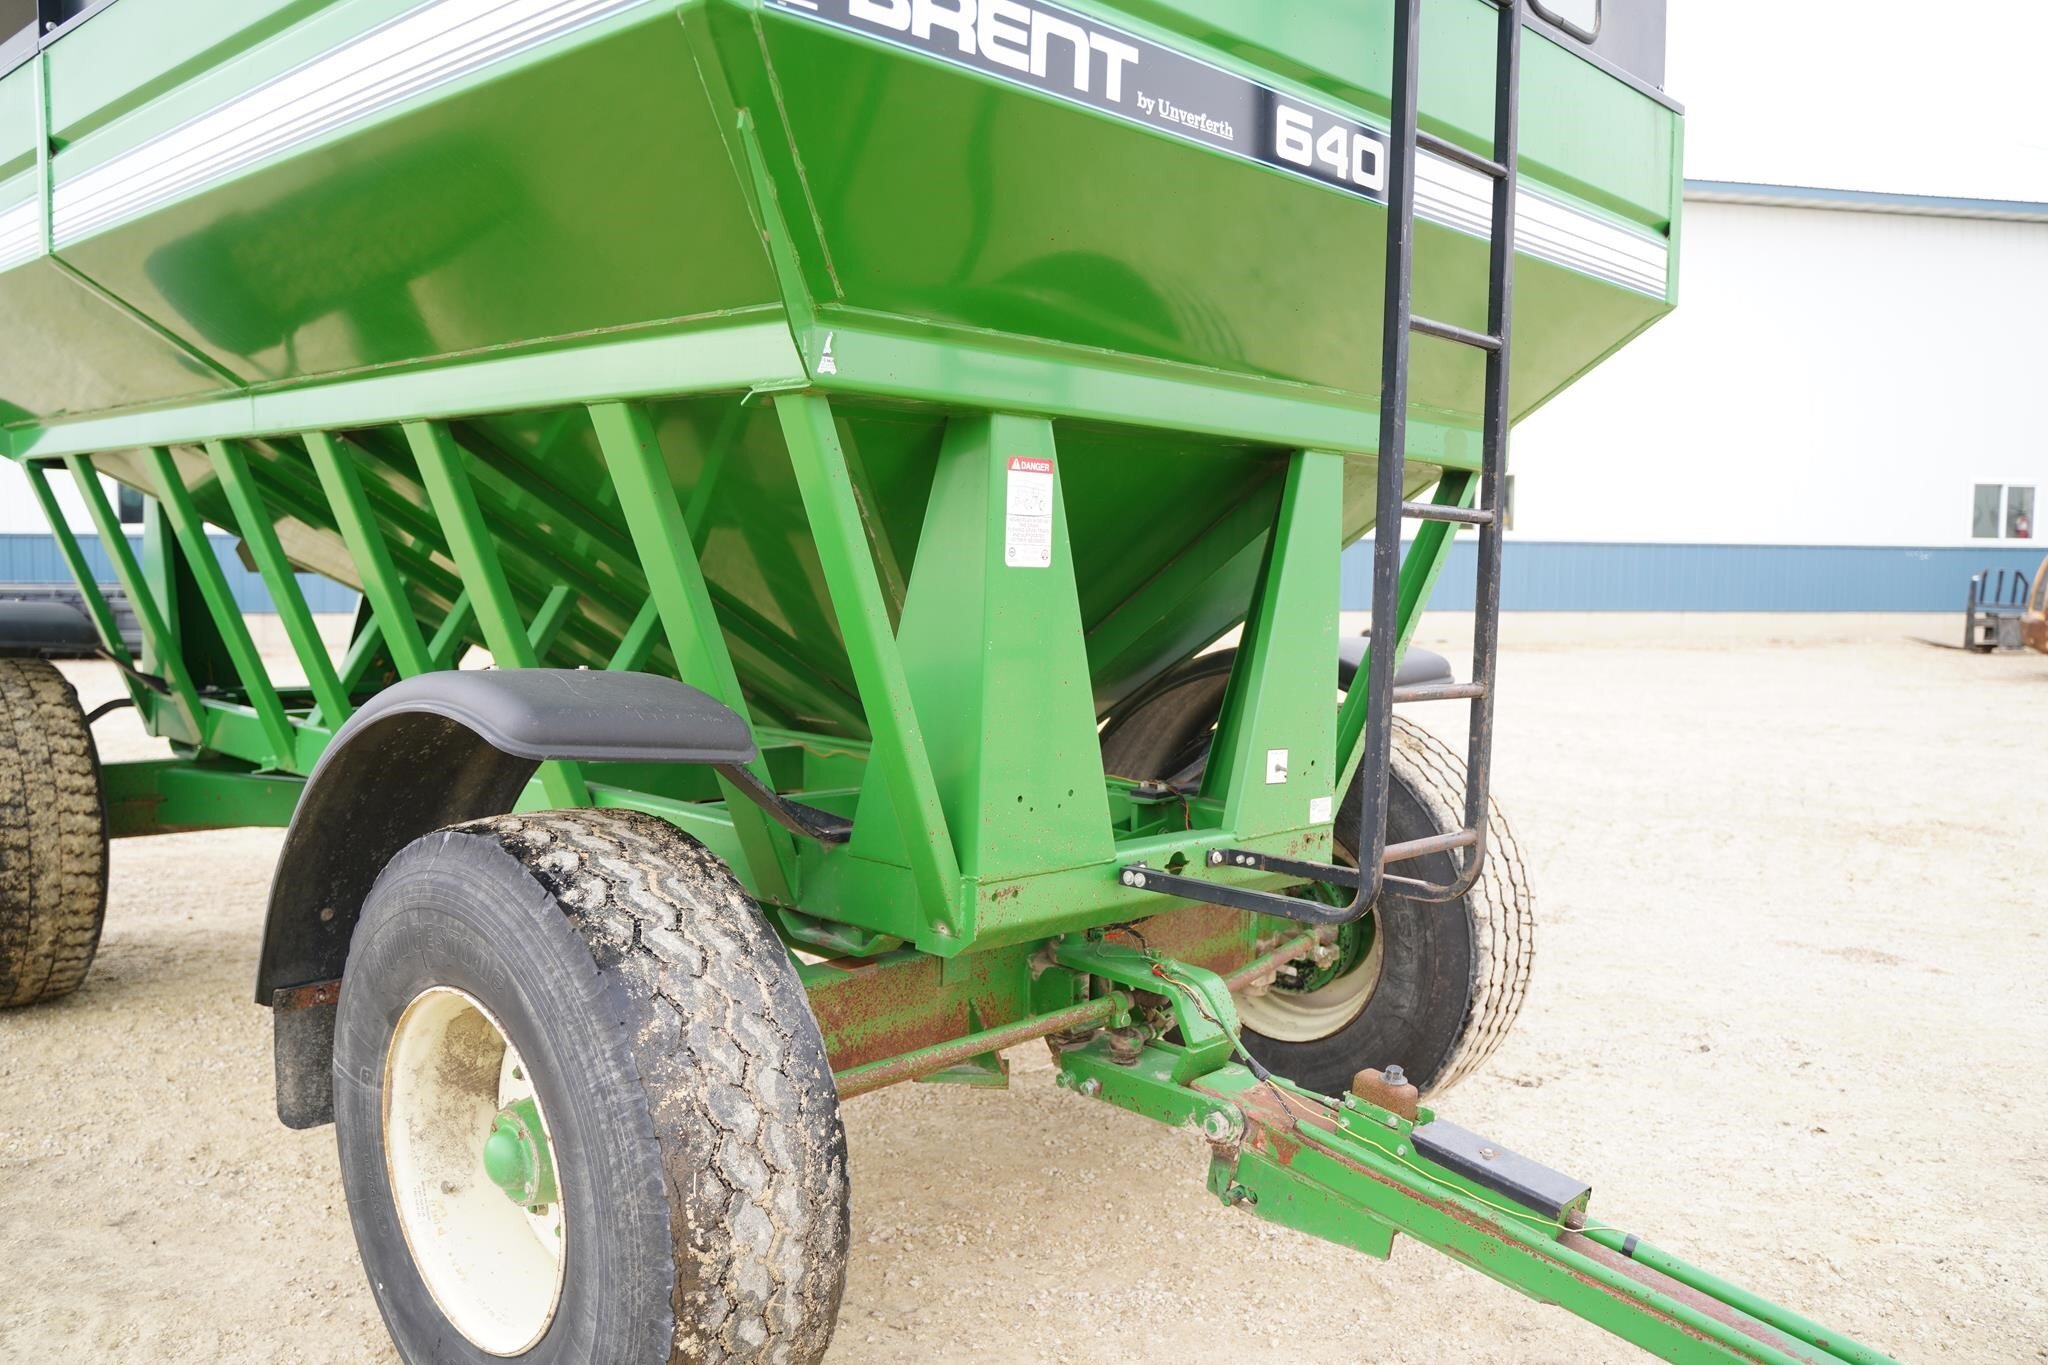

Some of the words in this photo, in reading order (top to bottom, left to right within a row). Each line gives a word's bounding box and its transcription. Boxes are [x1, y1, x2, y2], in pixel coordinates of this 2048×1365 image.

[1136, 91, 1156, 115] by
[1158, 98, 1234, 140] Unverferth
[1276, 104, 1385, 191] 640
[1021, 460, 1050, 472] DANGER
